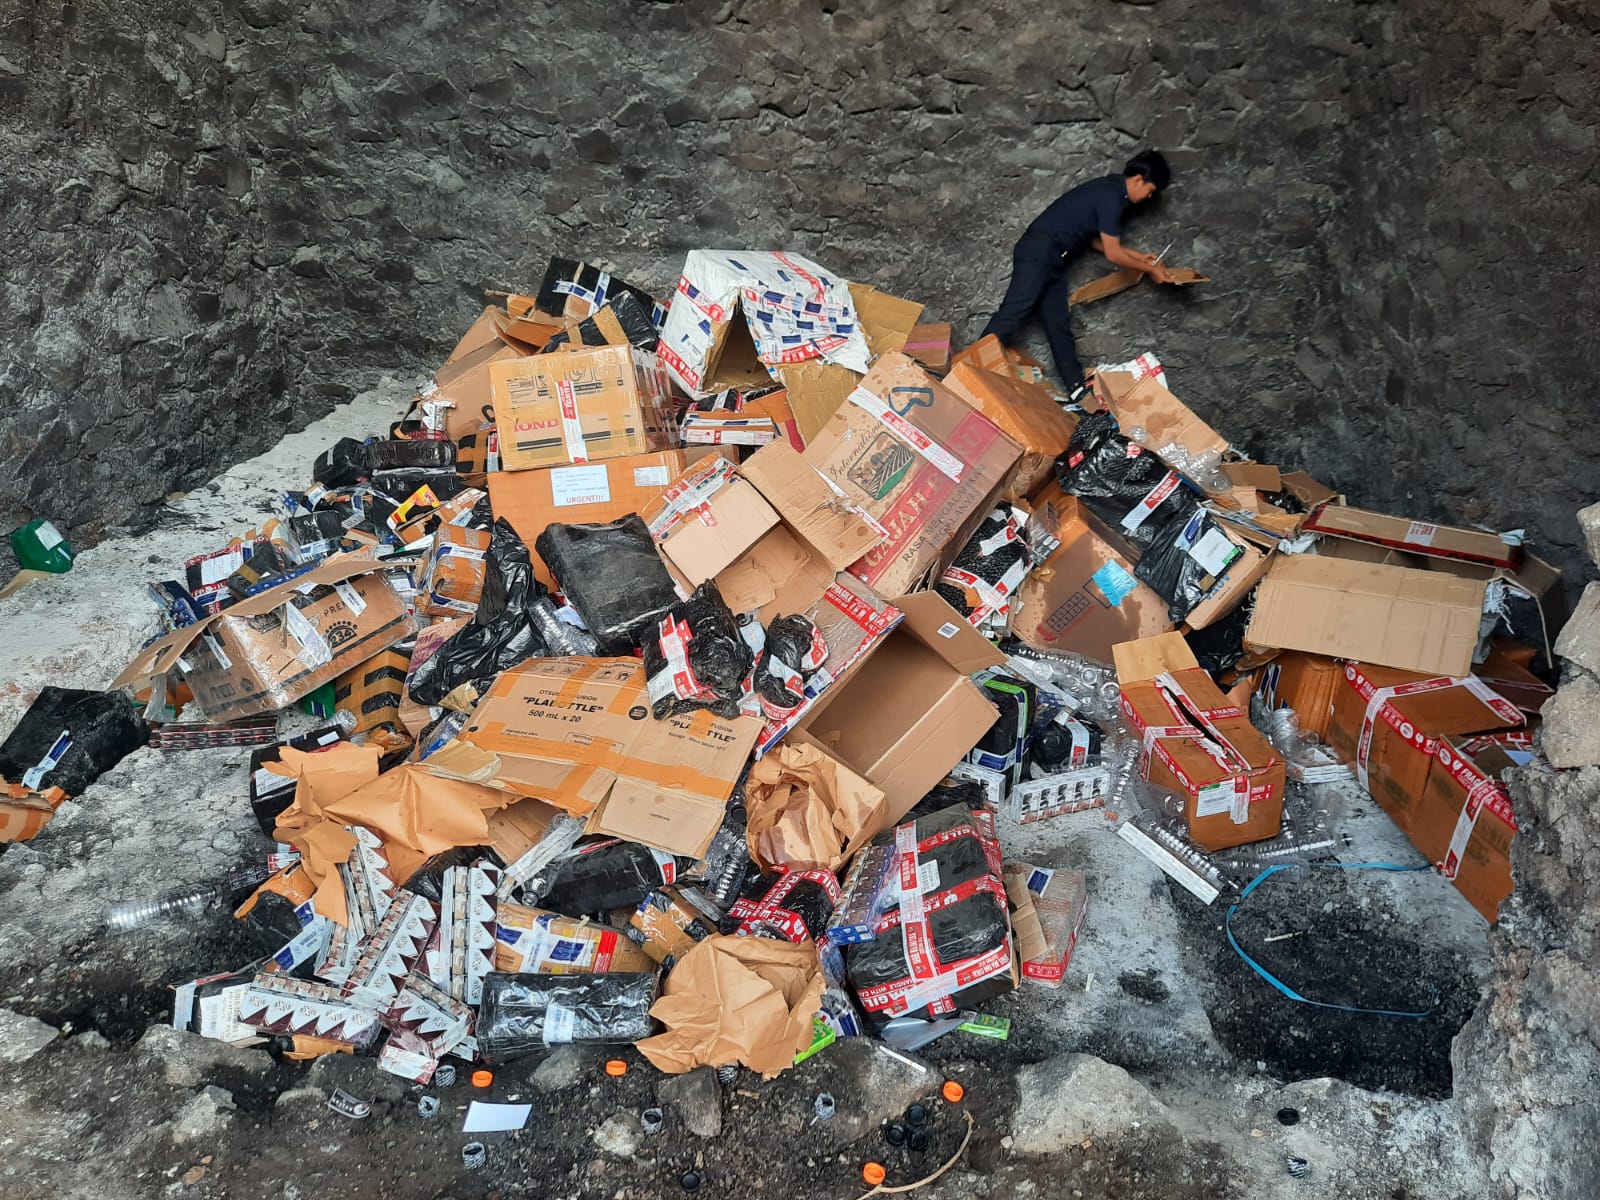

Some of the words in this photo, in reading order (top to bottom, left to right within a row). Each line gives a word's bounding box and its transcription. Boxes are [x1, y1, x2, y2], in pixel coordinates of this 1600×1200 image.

[830, 420, 884, 483] Internationa
[864, 490, 930, 567] GAJAH
[927, 428, 983, 497] BRU
[902, 536, 927, 563] RASA
[1363, 680, 1378, 695] FRAG
[528, 709, 545, 718] 500
[545, 712, 559, 720] mL
[568, 715, 582, 723] 20
[1461, 769, 1482, 787] FRAG
[760, 873, 801, 918] RAGILE
